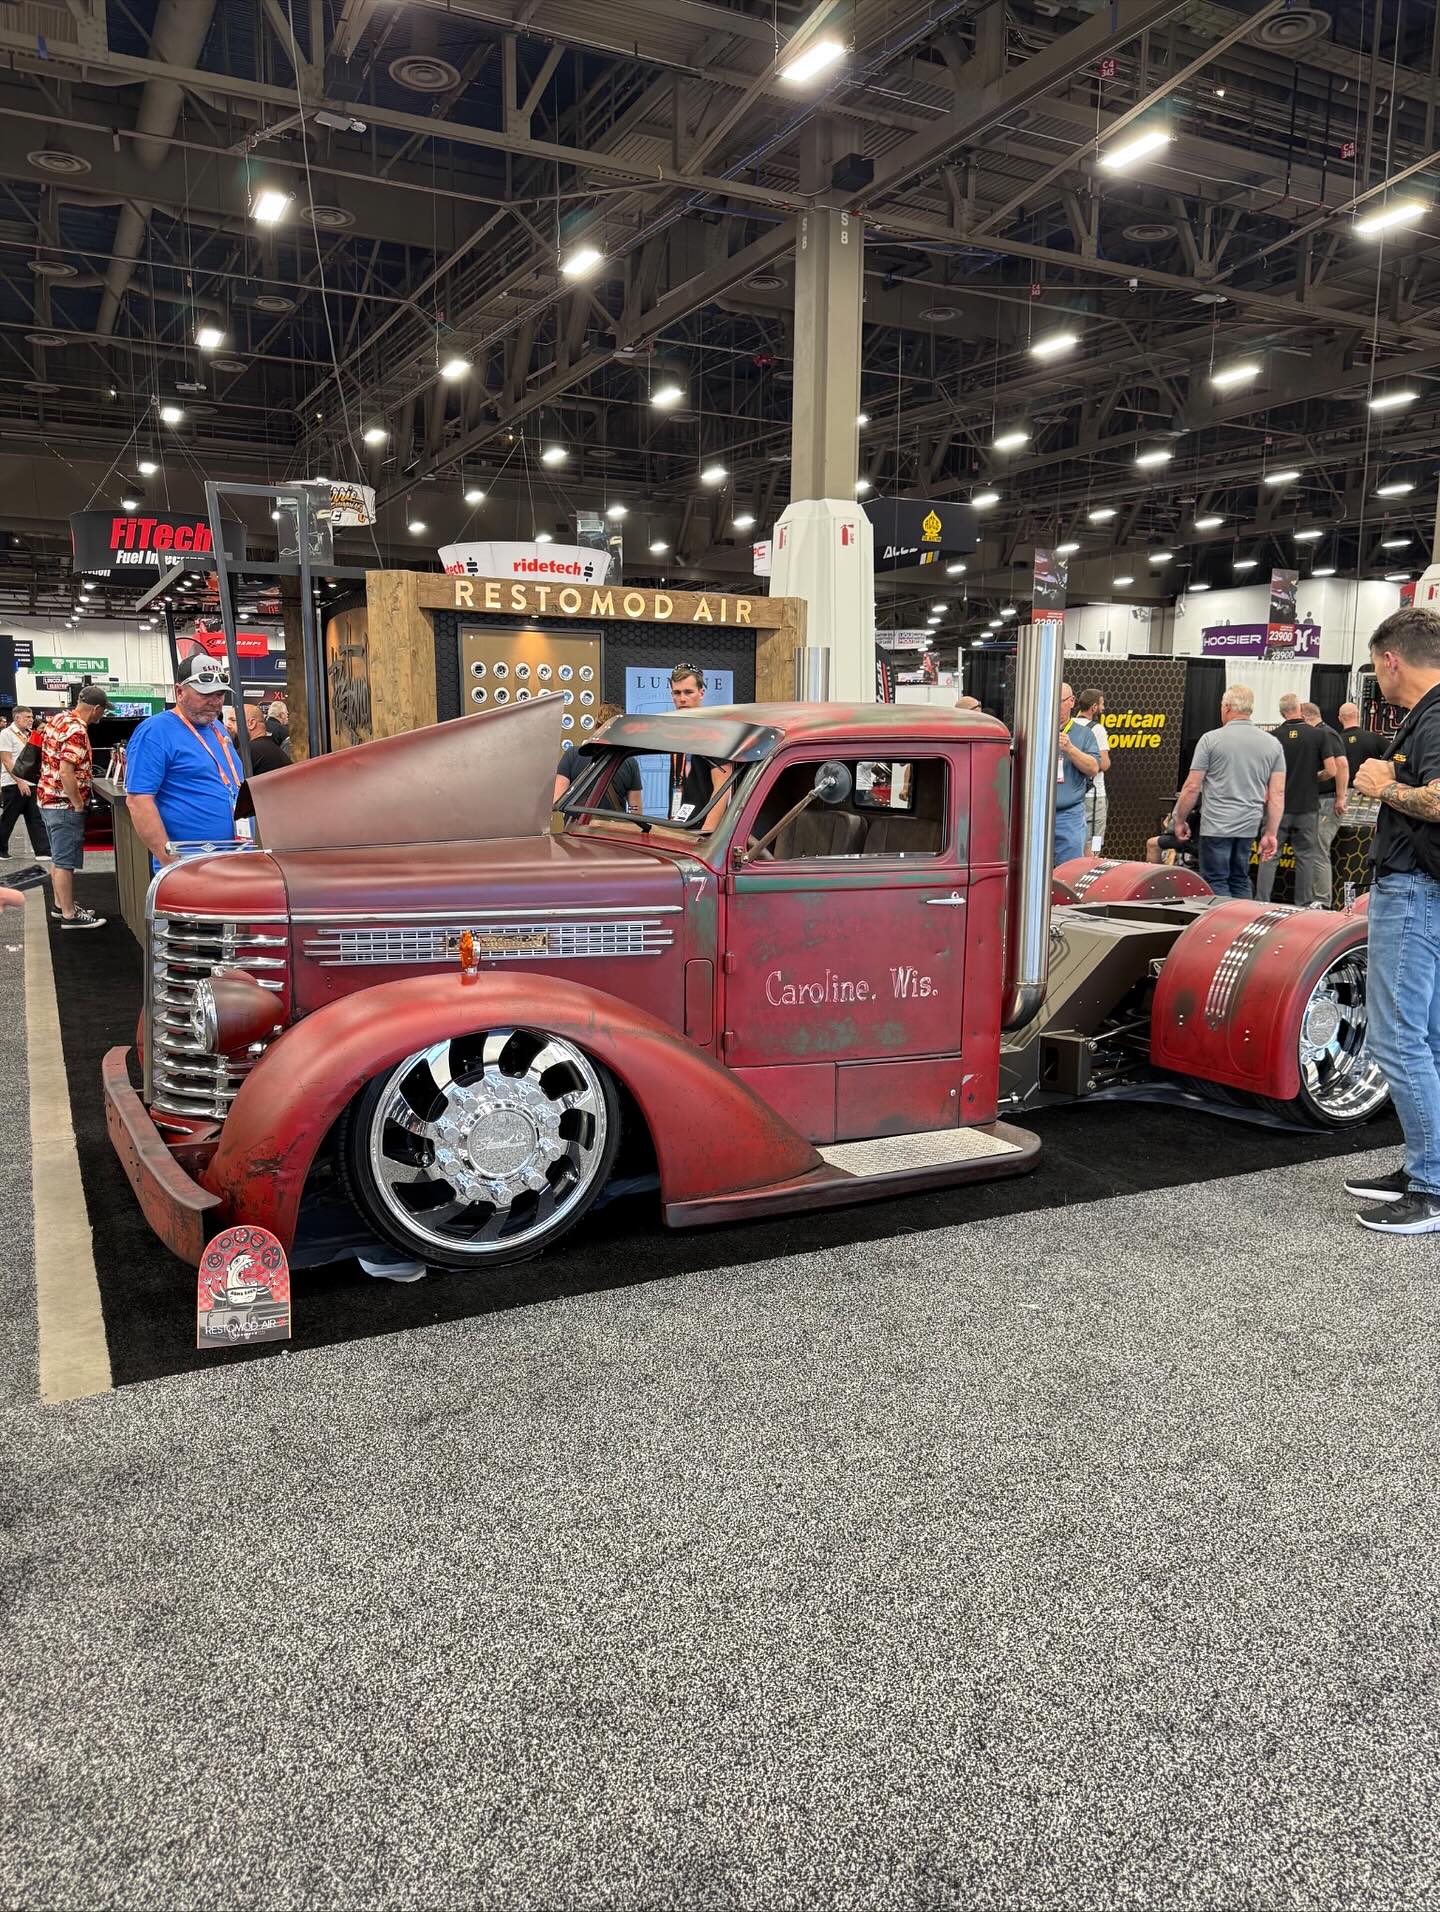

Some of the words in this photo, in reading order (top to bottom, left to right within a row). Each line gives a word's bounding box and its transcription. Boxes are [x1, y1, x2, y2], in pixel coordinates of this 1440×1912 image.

[109, 517, 213, 553] FiTech
[116, 550, 143, 564] Fuel
[513, 559, 582, 576] ridetech
[455, 580, 674, 620] RESTOMOD
[693, 597, 752, 624] AIR
[1203, 634, 1262, 646] HOOSIER
[1268, 631, 1293, 643] 23900
[1100, 710, 1166, 728] erican
[1107, 730, 1161, 748] owire
[688, 875, 707, 902] 7
[889, 965, 939, 999] Wis.
[205, 1321, 259, 1335] RESTOMOD
[260, 1319, 277, 1330] AIR
